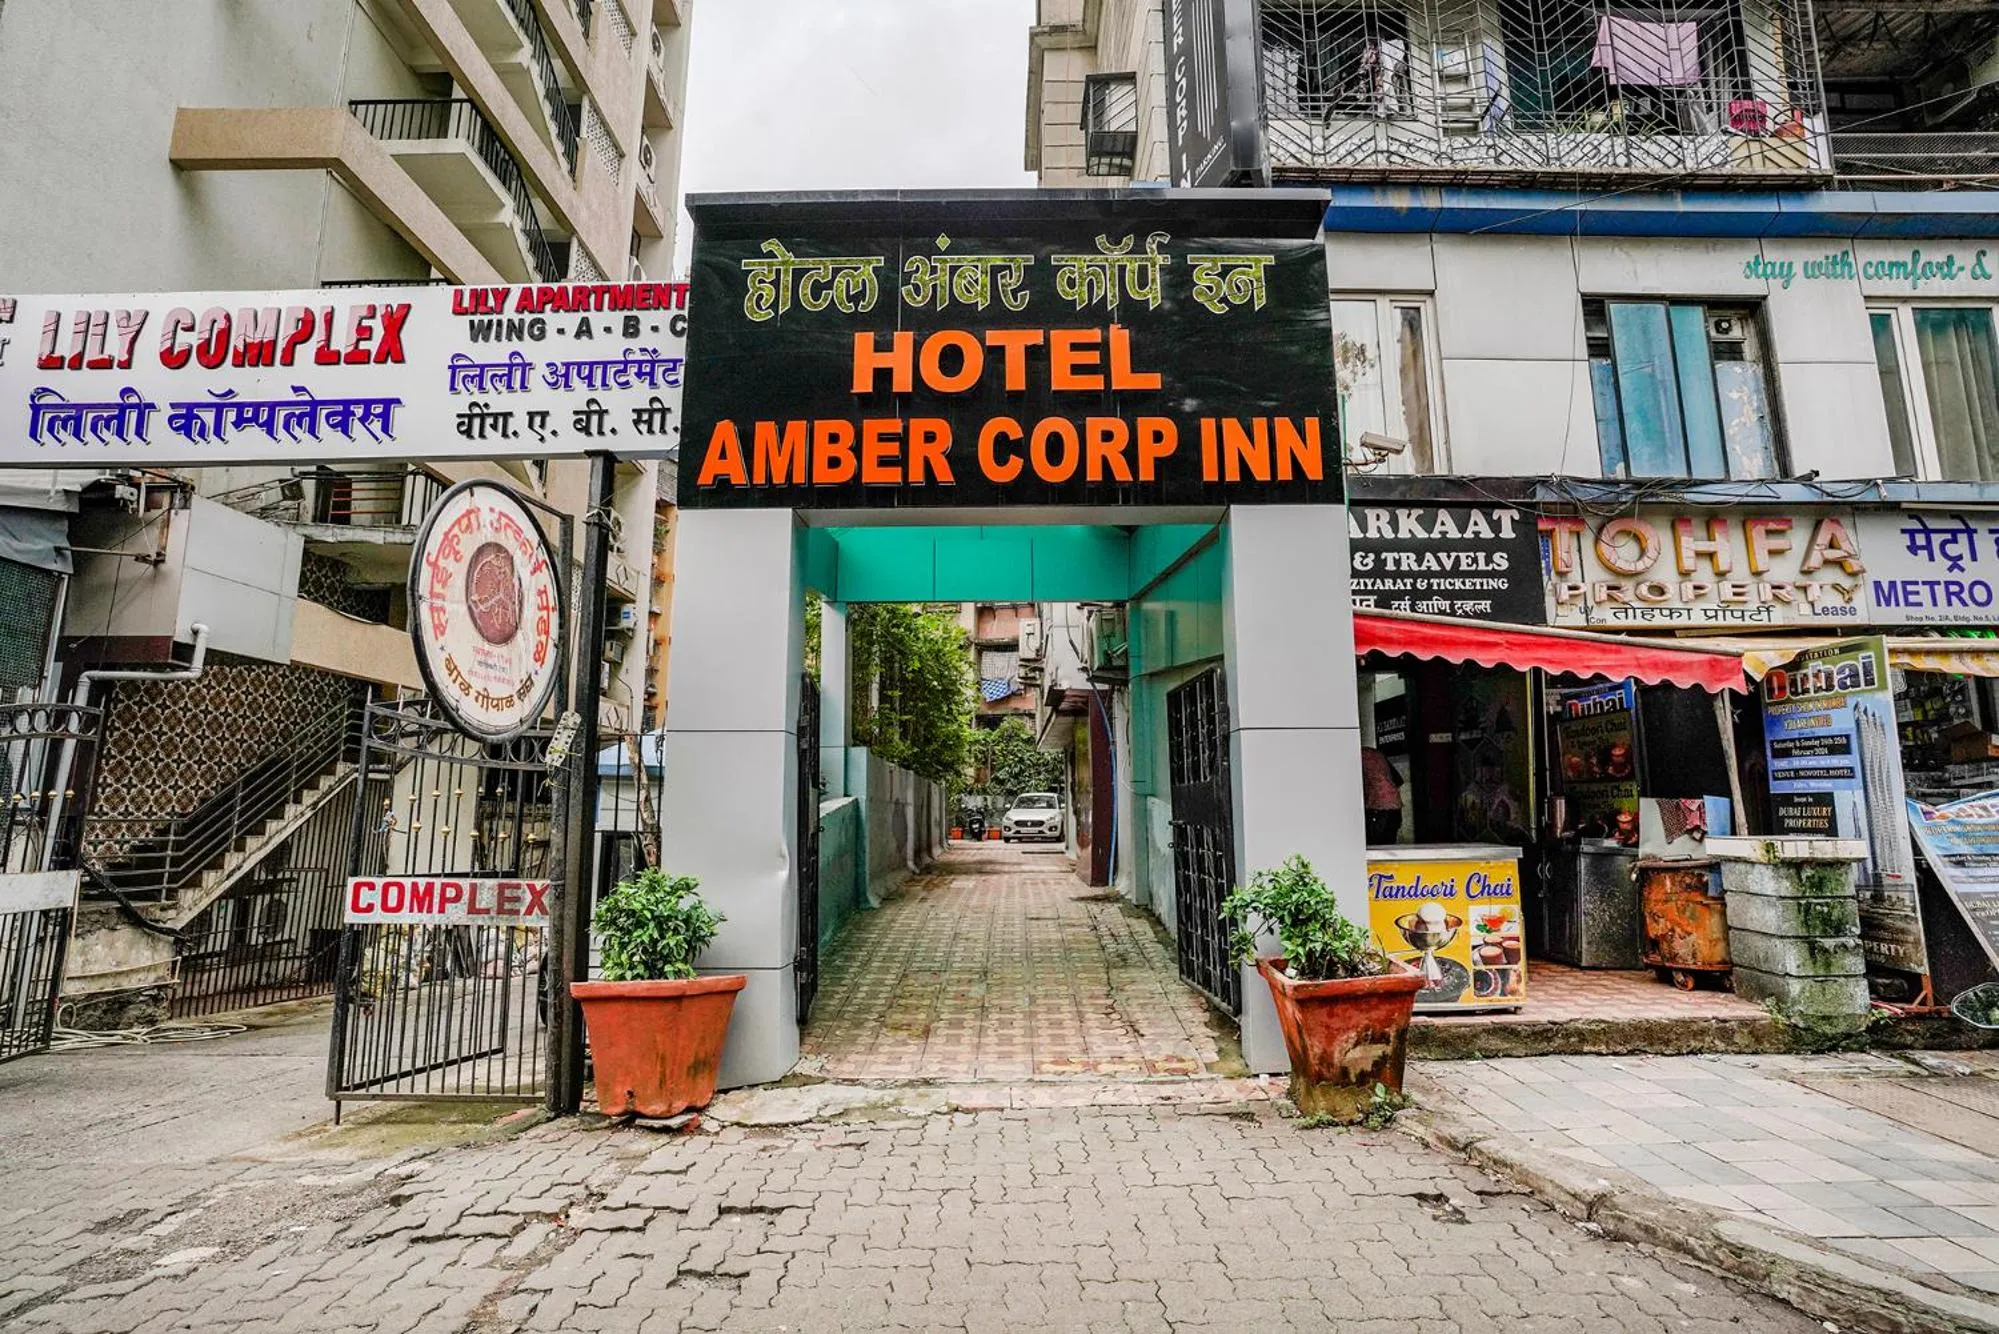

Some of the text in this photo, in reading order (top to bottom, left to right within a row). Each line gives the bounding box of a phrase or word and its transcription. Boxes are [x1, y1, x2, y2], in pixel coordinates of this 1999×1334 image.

[742, 231, 1275, 322] होटल अंबर कॉर्प इन
[1743, 254, 1797, 290] stay
[1803, 249, 1856, 281] with
[1970, 249, 1993, 281] &
[452, 283, 690, 316] LILY APARTMENT
[36, 308, 149, 370] LILY
[158, 303, 412, 370] COMPLEX
[469, 316, 547, 343] WING
[573, 316, 594, 340] A
[621, 314, 642, 339] B
[448, 347, 686, 395] लिली अपार्टमेंट
[850, 324, 1162, 394] HOTEL
[28, 385, 406, 447] लिली कॉम्पलेक्स
[696, 416, 1324, 488] AMBER CORP INN
[1352, 551, 1510, 571] & TRAVELS
[1537, 517, 1866, 575] TOHFA
[1900, 513, 1979, 573] मेट्रो
[1350, 578, 1509, 590] ZIYARAT & TICKETING
[1554, 581, 1863, 604] PROPERTY
[1872, 579, 1994, 608] METRO
[1610, 601, 1776, 623] तोहफा प्रॉपर्टी
[1811, 603, 1858, 617] Lease
[444, 653, 473, 696] बाळ
[474, 687, 516, 712] गोपाळ
[1764, 652, 1878, 703] Dubai
[350, 880, 550, 917] COMPLEX
[1368, 872, 1513, 899] Tandoori Chai
